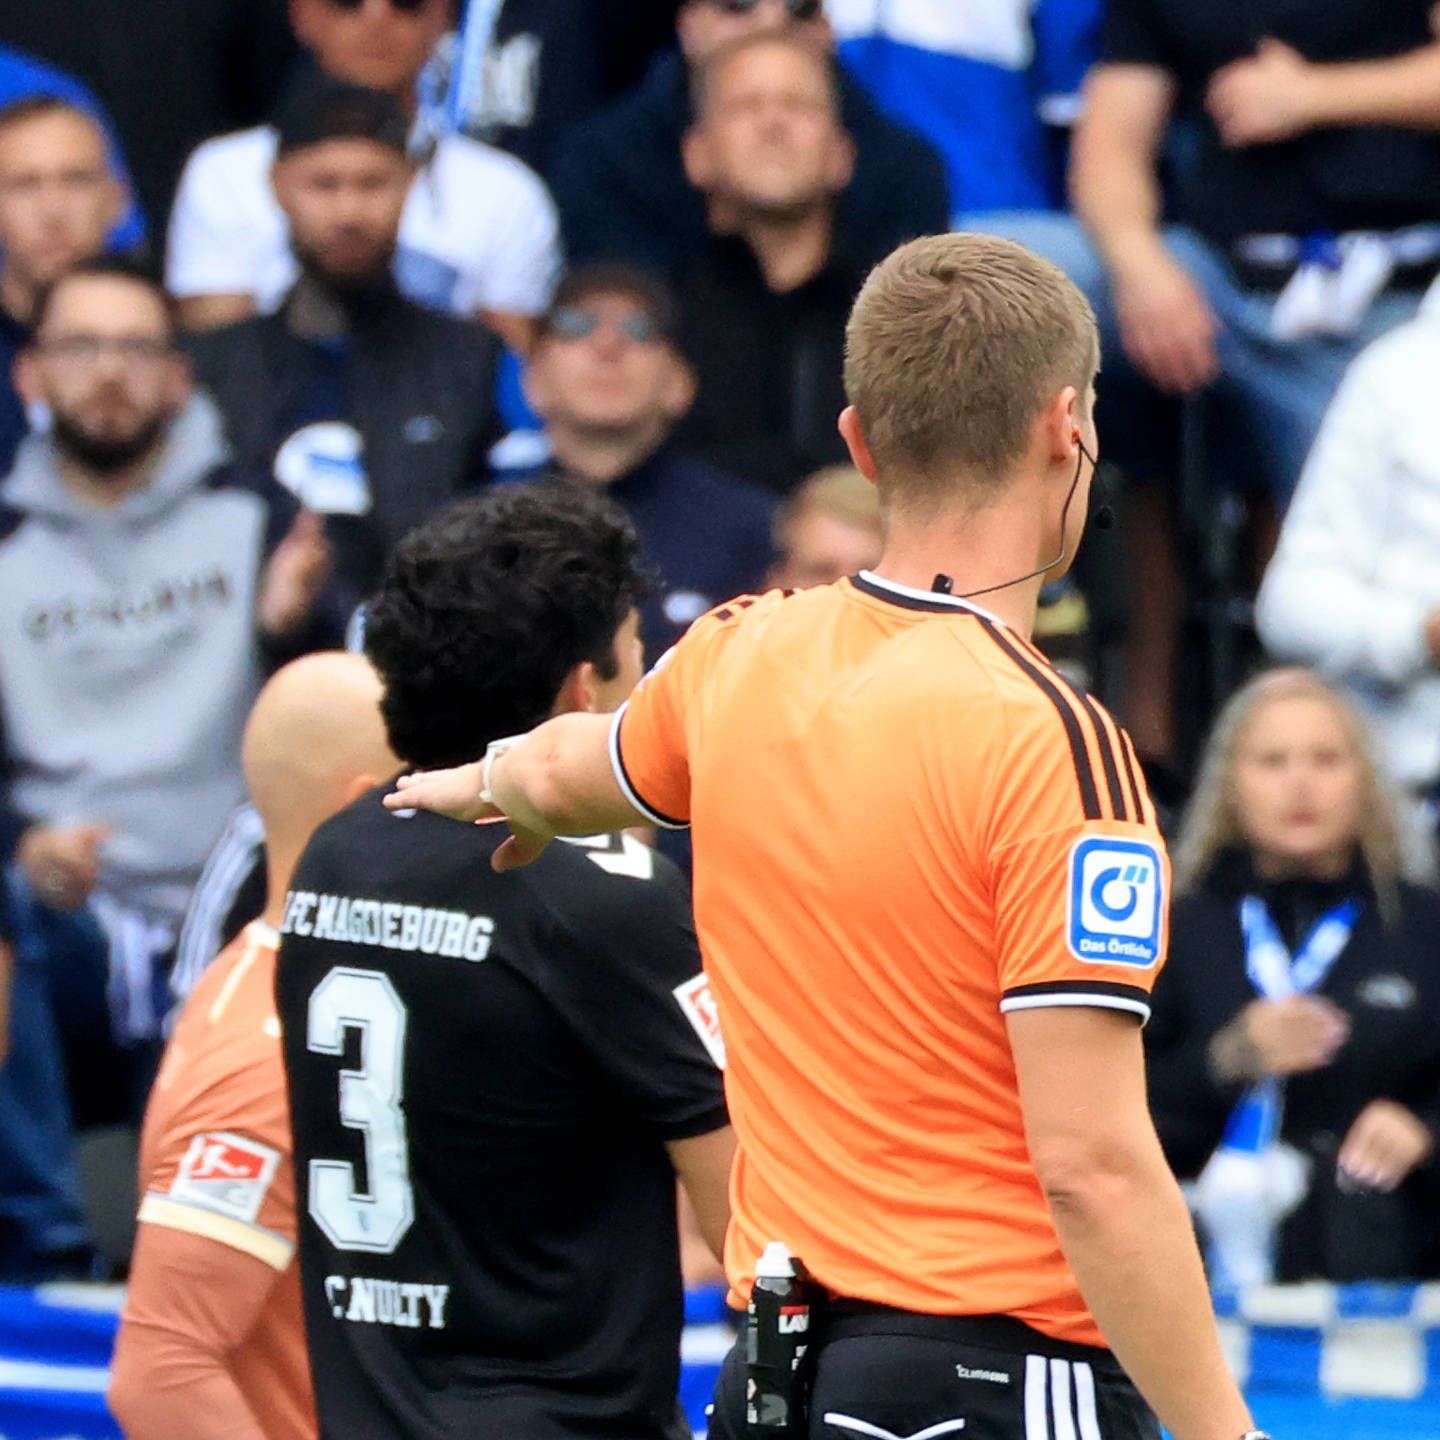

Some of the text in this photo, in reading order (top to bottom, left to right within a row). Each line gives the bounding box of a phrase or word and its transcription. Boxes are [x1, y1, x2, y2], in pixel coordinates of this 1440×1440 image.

[312, 894, 493, 961] MAGDEBURG
[1080, 939, 1106, 952] Das
[307, 966, 415, 1253] 3
